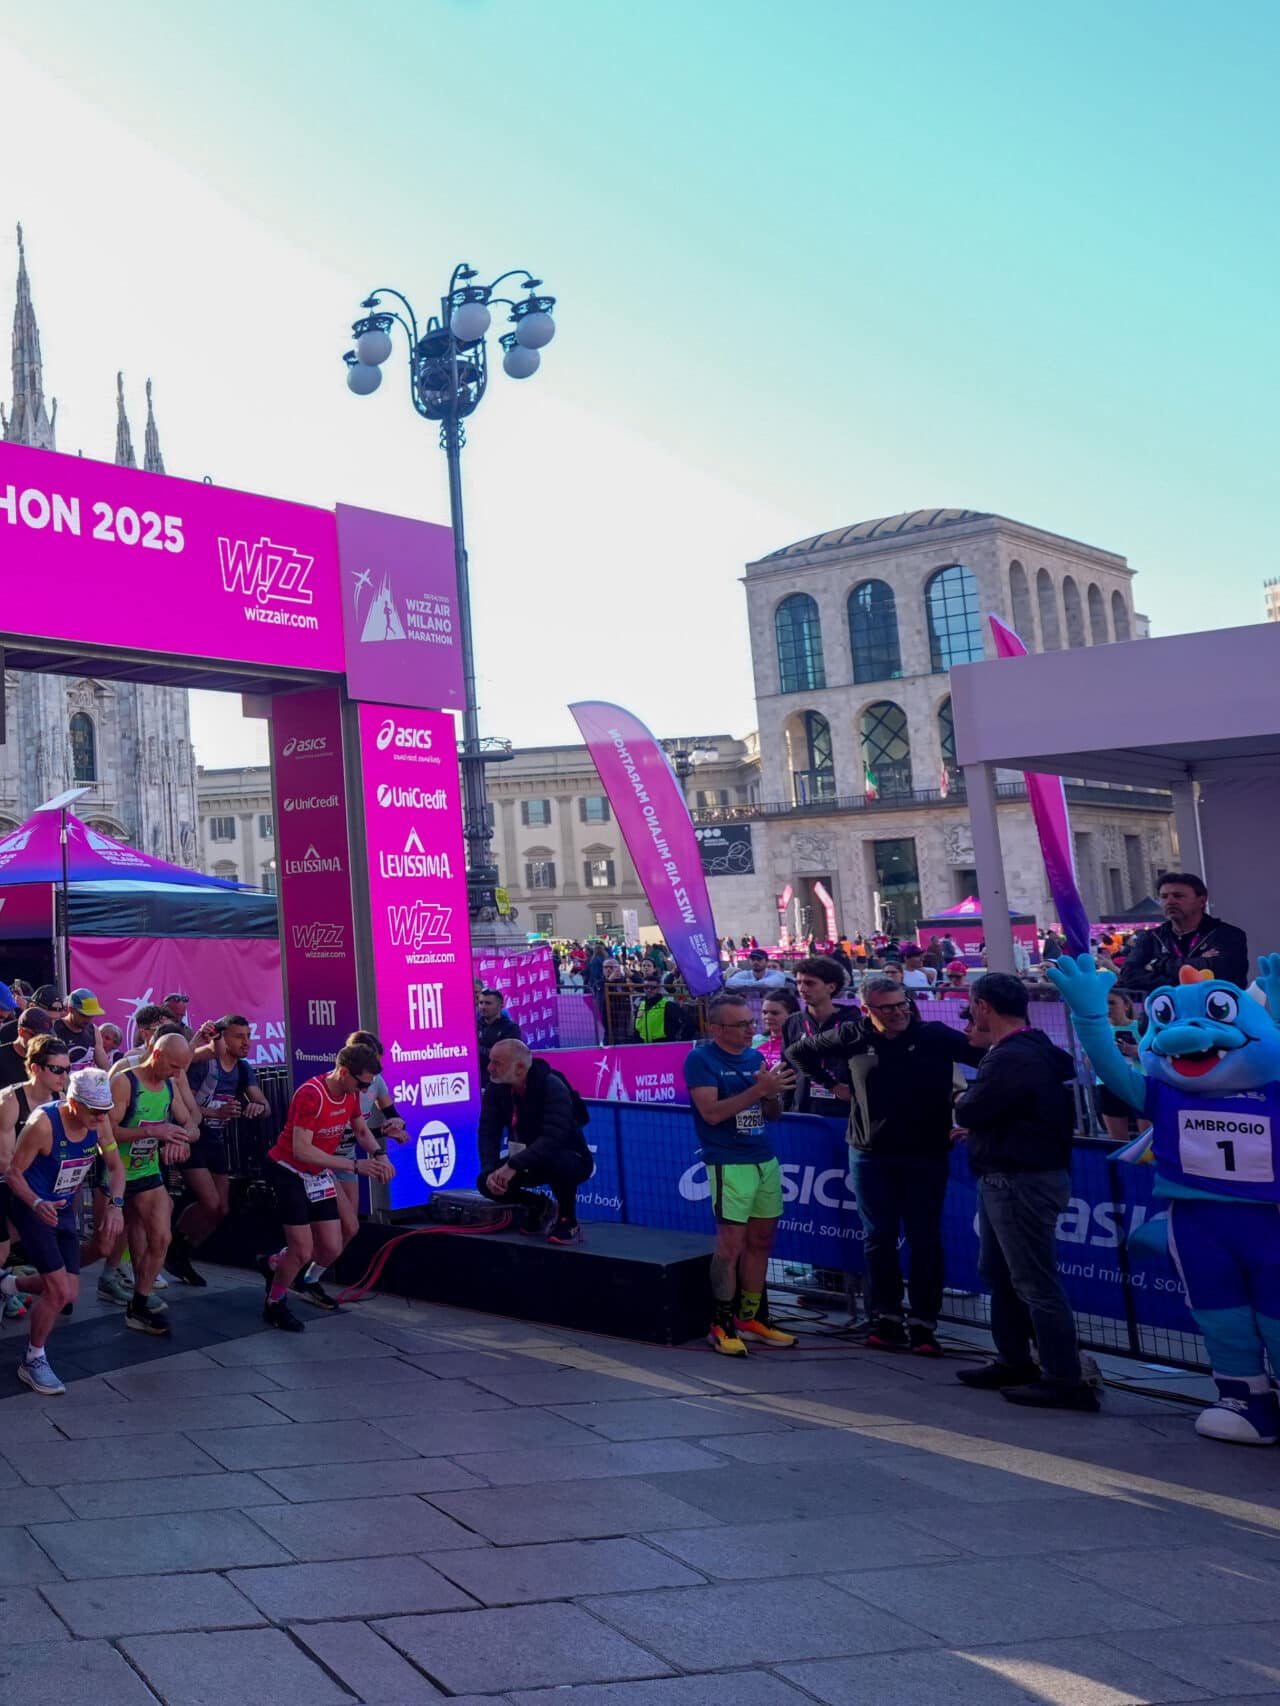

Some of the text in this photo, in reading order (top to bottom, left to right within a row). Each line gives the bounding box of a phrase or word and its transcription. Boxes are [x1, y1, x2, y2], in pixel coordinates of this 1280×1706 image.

[92, 502, 185, 553] 2025
[243, 605, 319, 630] wizzair.com
[405, 599, 451, 618] WIZZ AIR
[406, 613, 453, 633] MILANO
[407, 629, 453, 646] MARATHON
[295, 795, 339, 810] UniCredit
[392, 786, 448, 810] UniCredit
[285, 856, 341, 874] LEVISSIMA
[379, 850, 451, 879] LEVISSIMA
[305, 950, 346, 959] wizzair.com
[405, 951, 455, 964] wizzair.com
[308, 1000, 337, 1026] FIAT
[407, 983, 444, 1030] FIAT
[635, 1072, 674, 1087] WIZZ AIR
[392, 1079, 450, 1106] sky wifi
[635, 1086, 676, 1102] MILANO
[1183, 1117, 1265, 1136] AMBROGIO
[423, 1138, 449, 1158] RTL
[1215, 1141, 1236, 1172] 1
[424, 1156, 450, 1170] 102.5
[594, 1192, 623, 1211] body
[777, 1217, 815, 1236] mind,
[1055, 1261, 1095, 1279] ound
[1098, 1267, 1148, 1289] mind,
